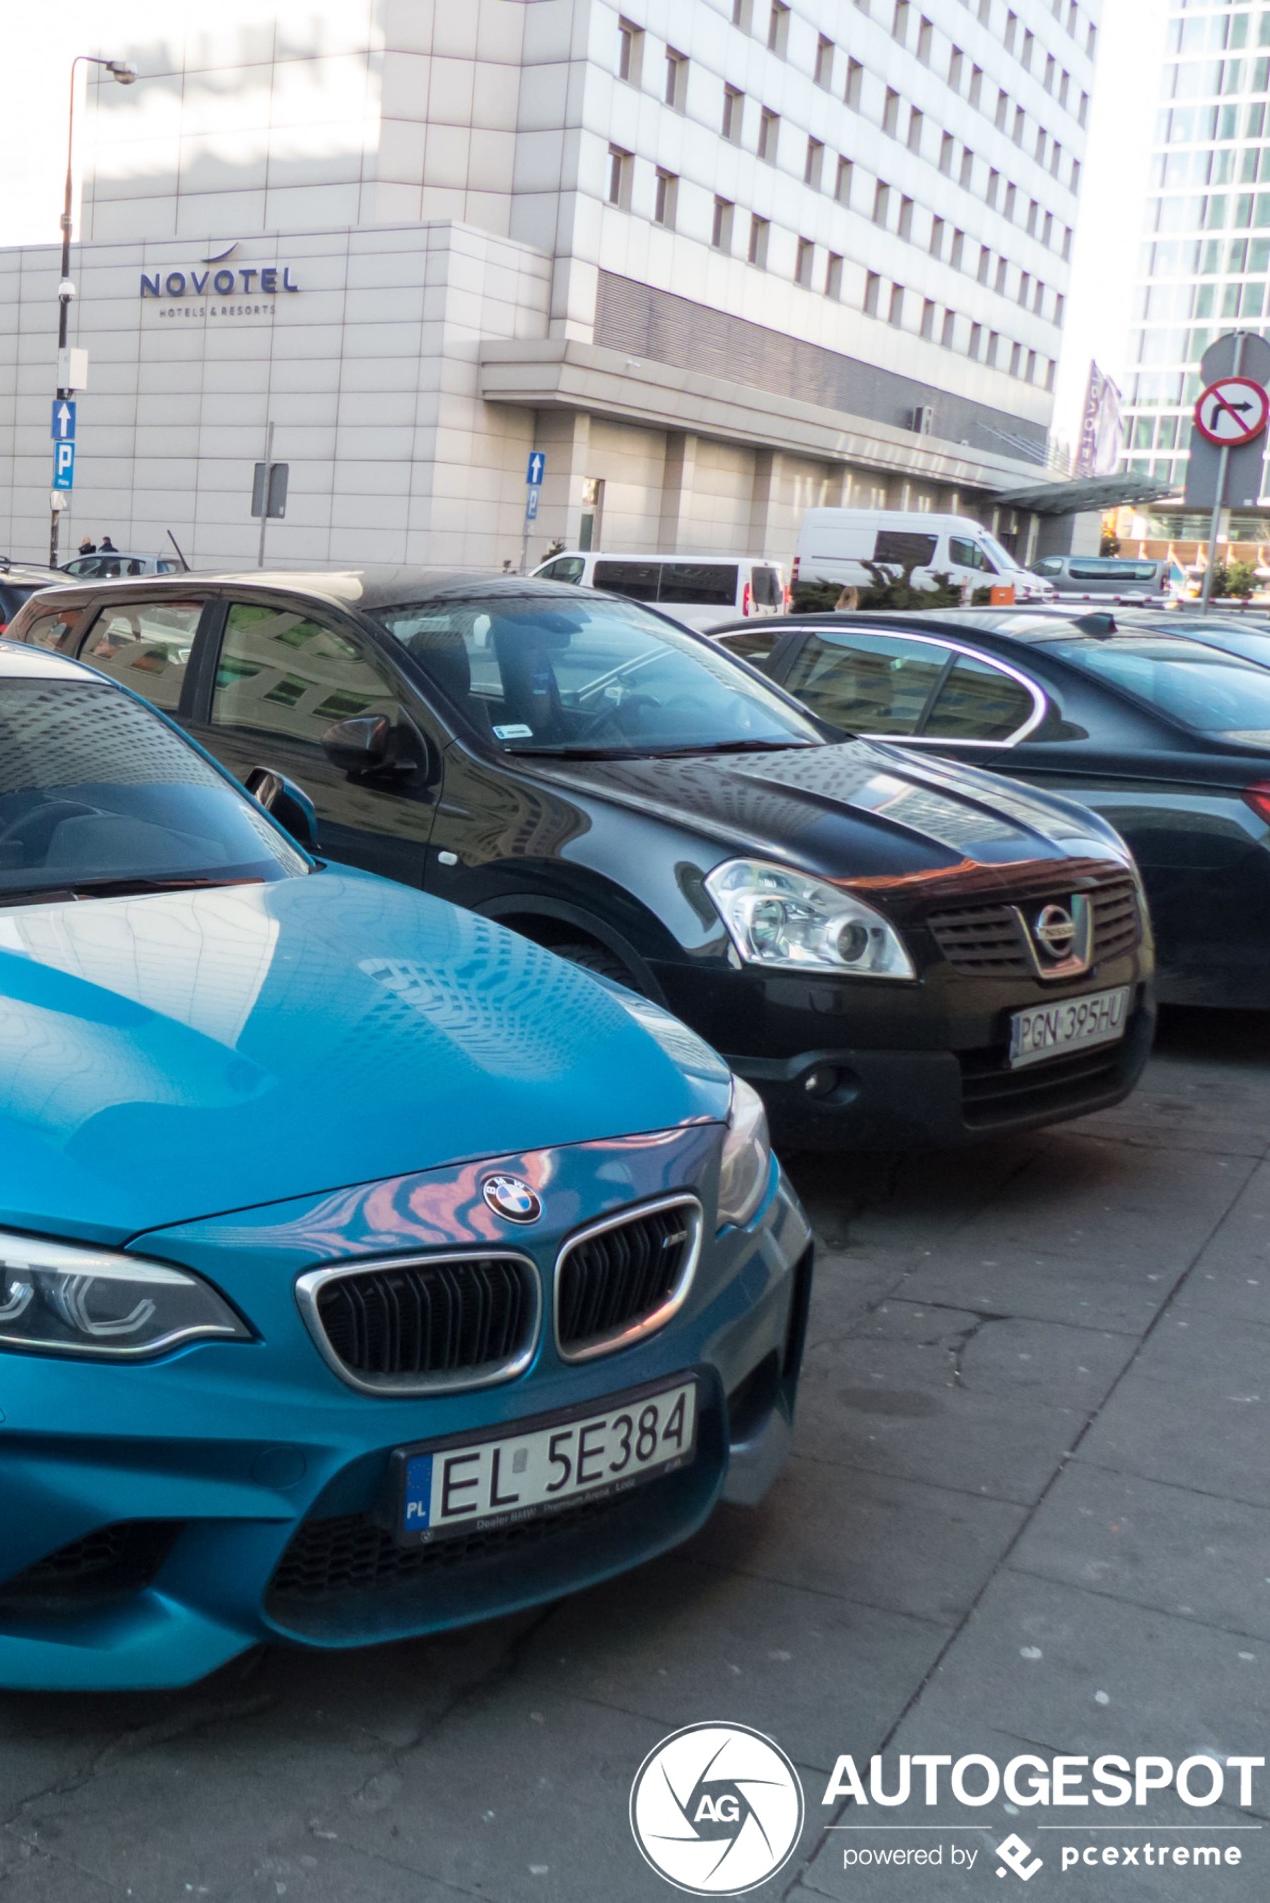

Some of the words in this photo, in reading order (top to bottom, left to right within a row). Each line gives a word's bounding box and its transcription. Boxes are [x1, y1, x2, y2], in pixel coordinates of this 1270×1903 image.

[140, 267, 299, 298] NOVOTEL
[159, 306, 206, 318] HOTELS
[210, 306, 217, 317] &
[221, 304, 276, 316] RESORTS
[58, 444, 72, 475] P
[1022, 1009, 1059, 1052] PGN
[1064, 993, 1126, 1040] 395HU
[486, 1176, 526, 1195] BMW
[440, 1447, 520, 1518] EL
[545, 1392, 687, 1493] 5E384
[406, 1500, 426, 1520] PL
[476, 1515, 509, 1531] Dealer
[510, 1507, 537, 1523] BMW
